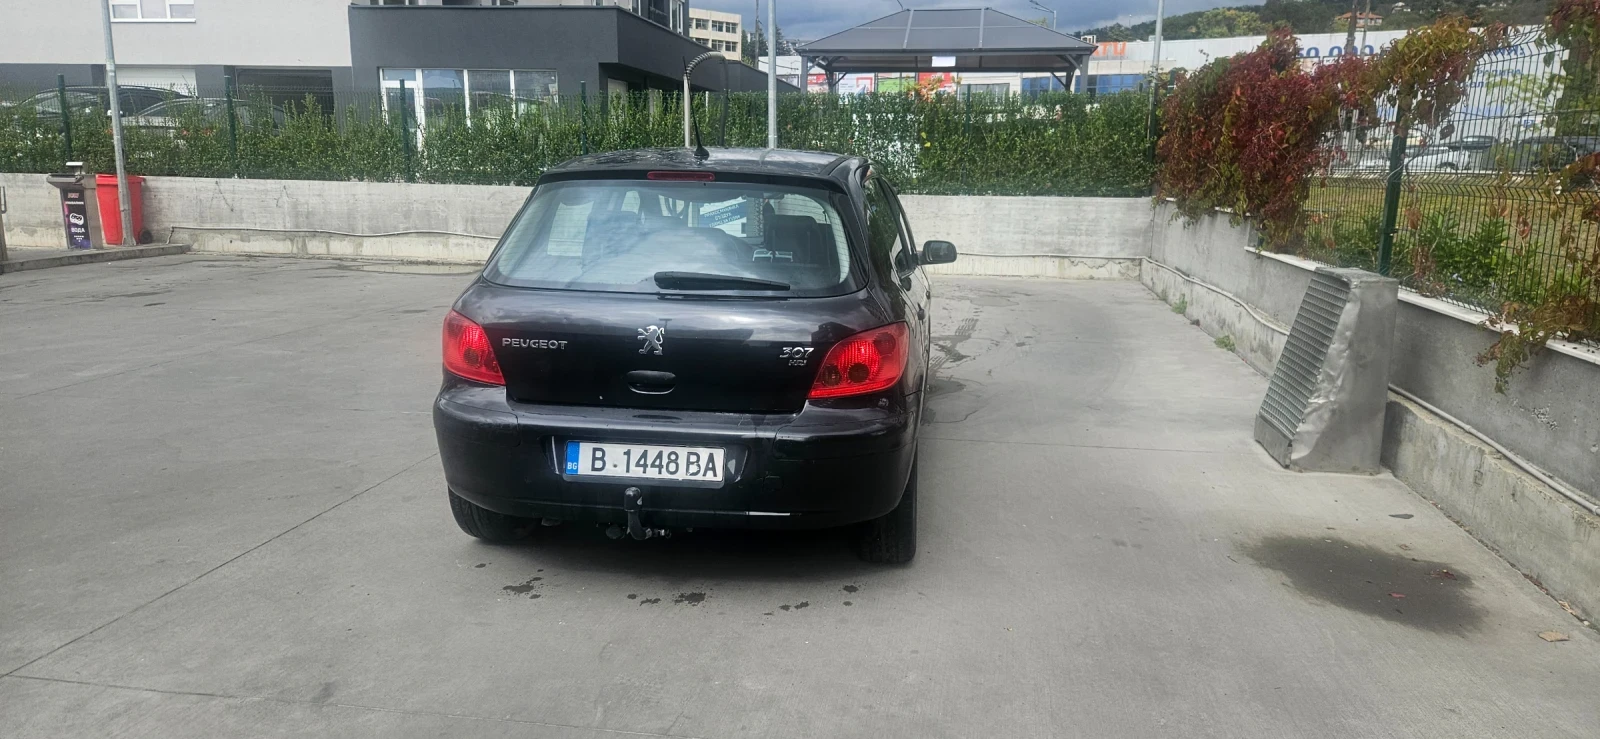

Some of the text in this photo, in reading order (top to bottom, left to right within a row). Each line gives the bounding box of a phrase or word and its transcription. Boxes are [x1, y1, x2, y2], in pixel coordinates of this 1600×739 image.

[502, 337, 568, 350] PEUGEOT
[779, 346, 815, 358] 307
[567, 461, 578, 470] BG
